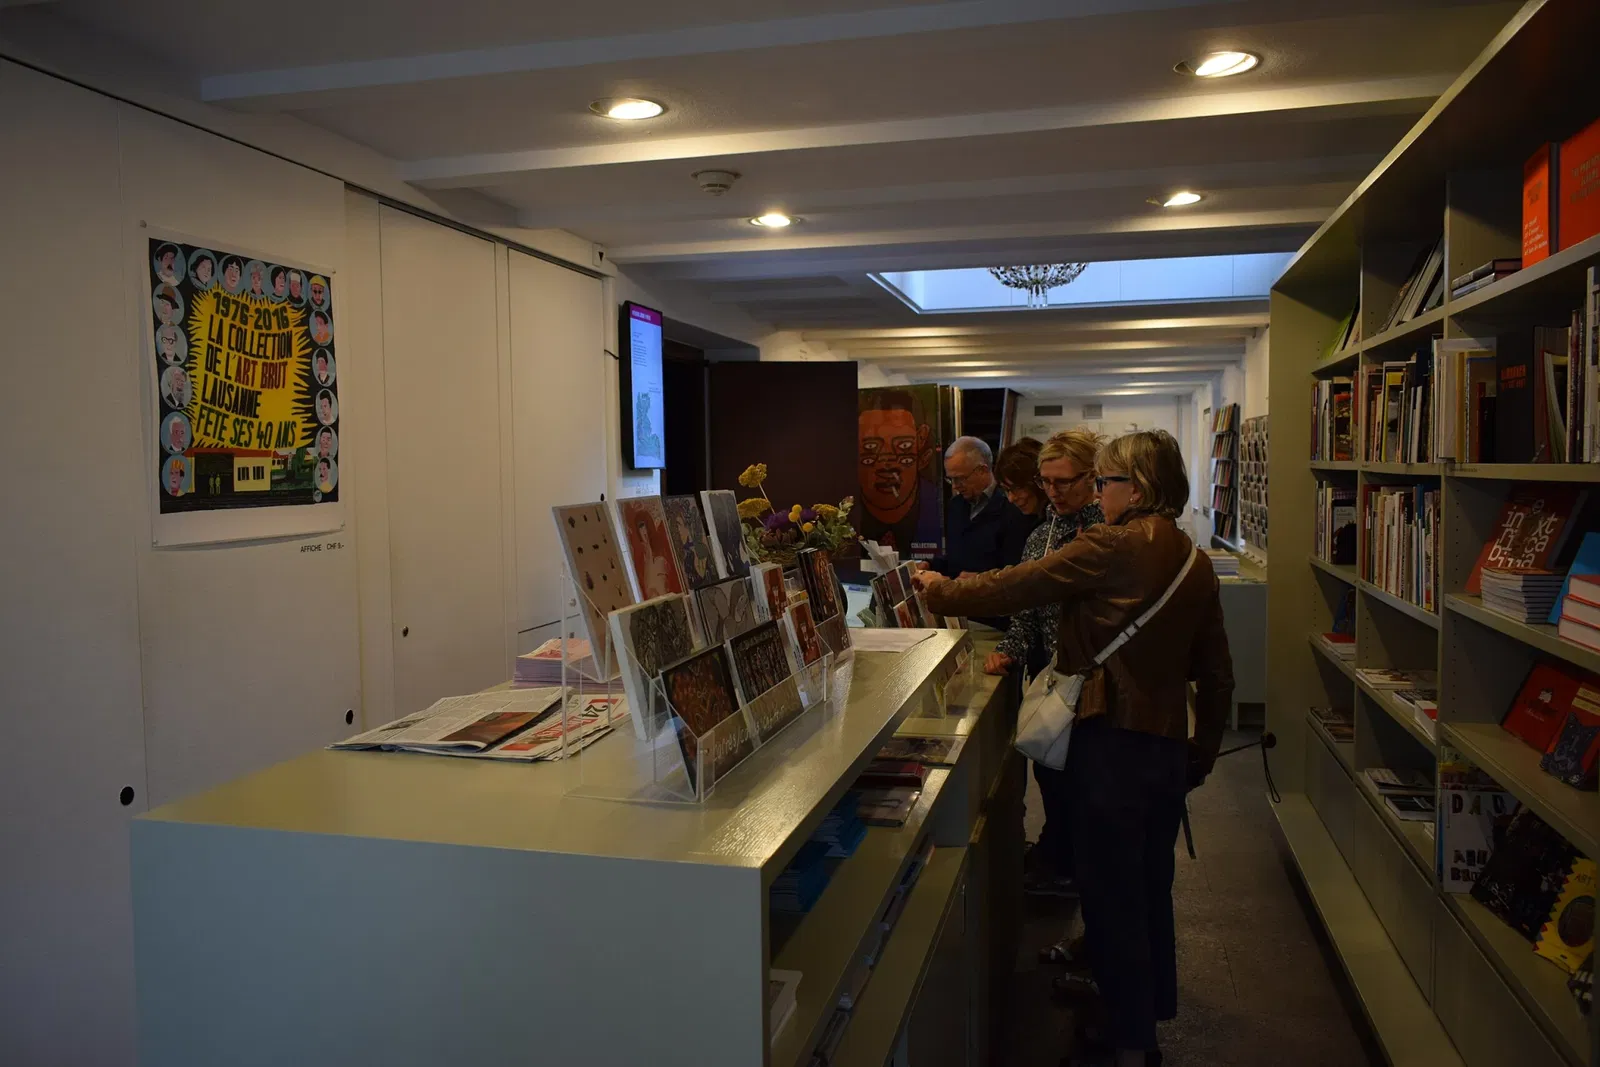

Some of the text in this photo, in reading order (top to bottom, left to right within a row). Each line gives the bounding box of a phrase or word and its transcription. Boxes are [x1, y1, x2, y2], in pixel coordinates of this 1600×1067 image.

[213, 291, 290, 331] 1976-2016
[208, 314, 293, 360] LA COLLECTION
[205, 343, 288, 389] DE L'ART BRUT
[201, 374, 262, 418] LAUSANNE
[230, 418, 254, 447] SES
[257, 421, 273, 449] 40
[275, 421, 297, 448] ANS
[300, 544, 322, 553] AFFICHE
[326, 542, 337, 550] CHF
